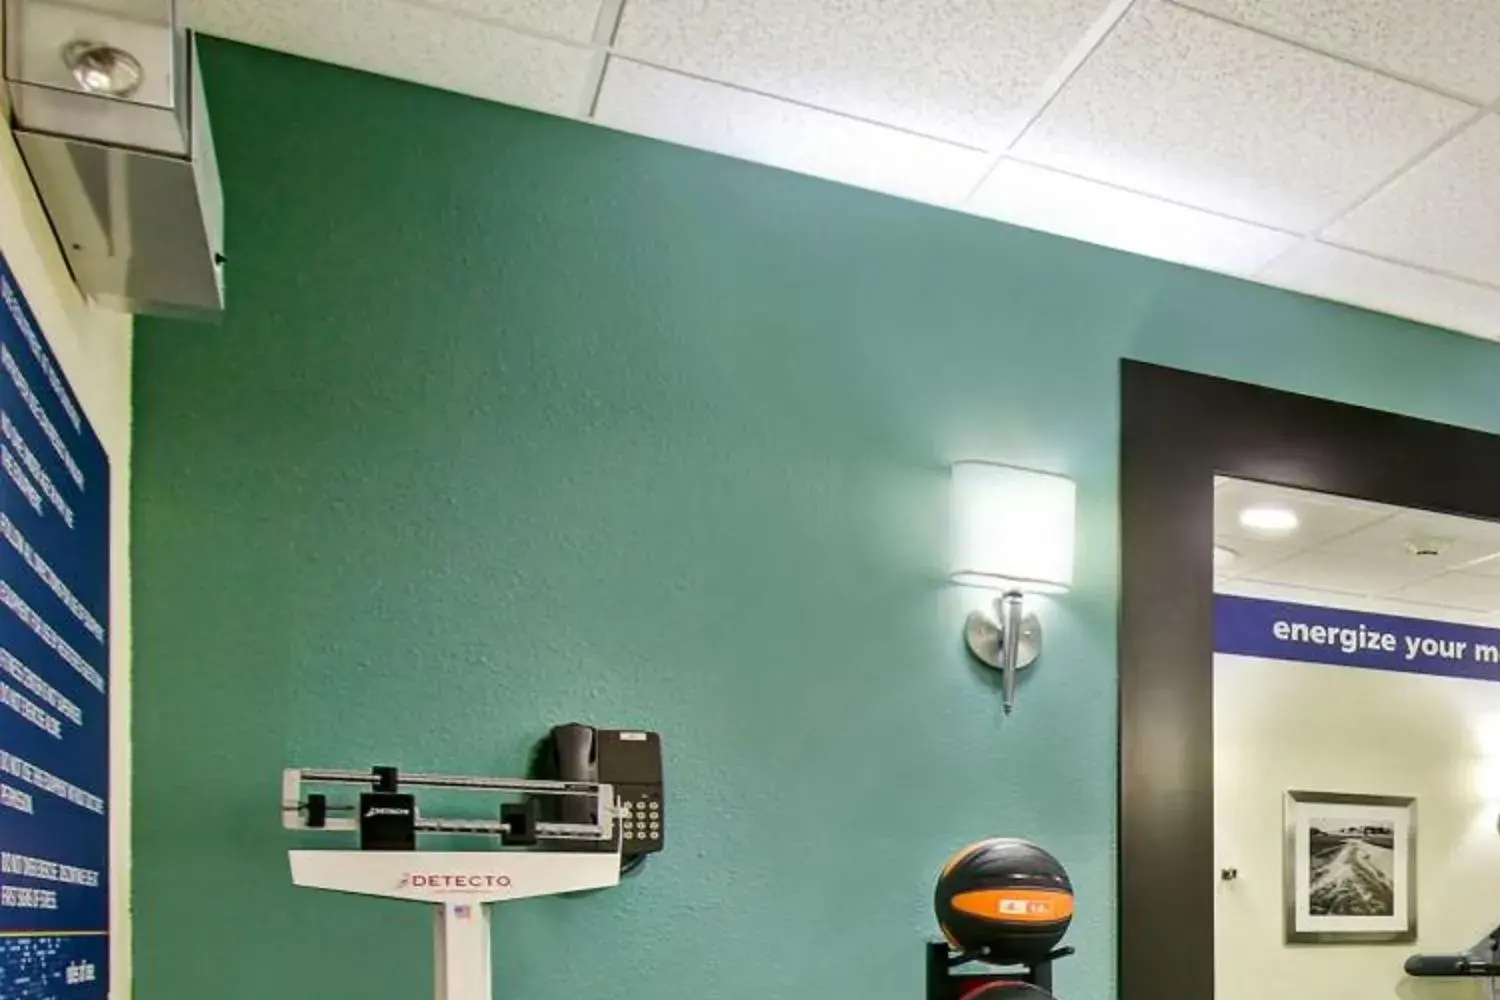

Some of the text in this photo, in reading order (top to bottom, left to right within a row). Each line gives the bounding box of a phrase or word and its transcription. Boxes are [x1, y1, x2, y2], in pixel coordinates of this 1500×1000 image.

[1272, 619, 1397, 653] energize
[1404, 635, 1467, 661] your
[411, 874, 512, 888] DETECTO
